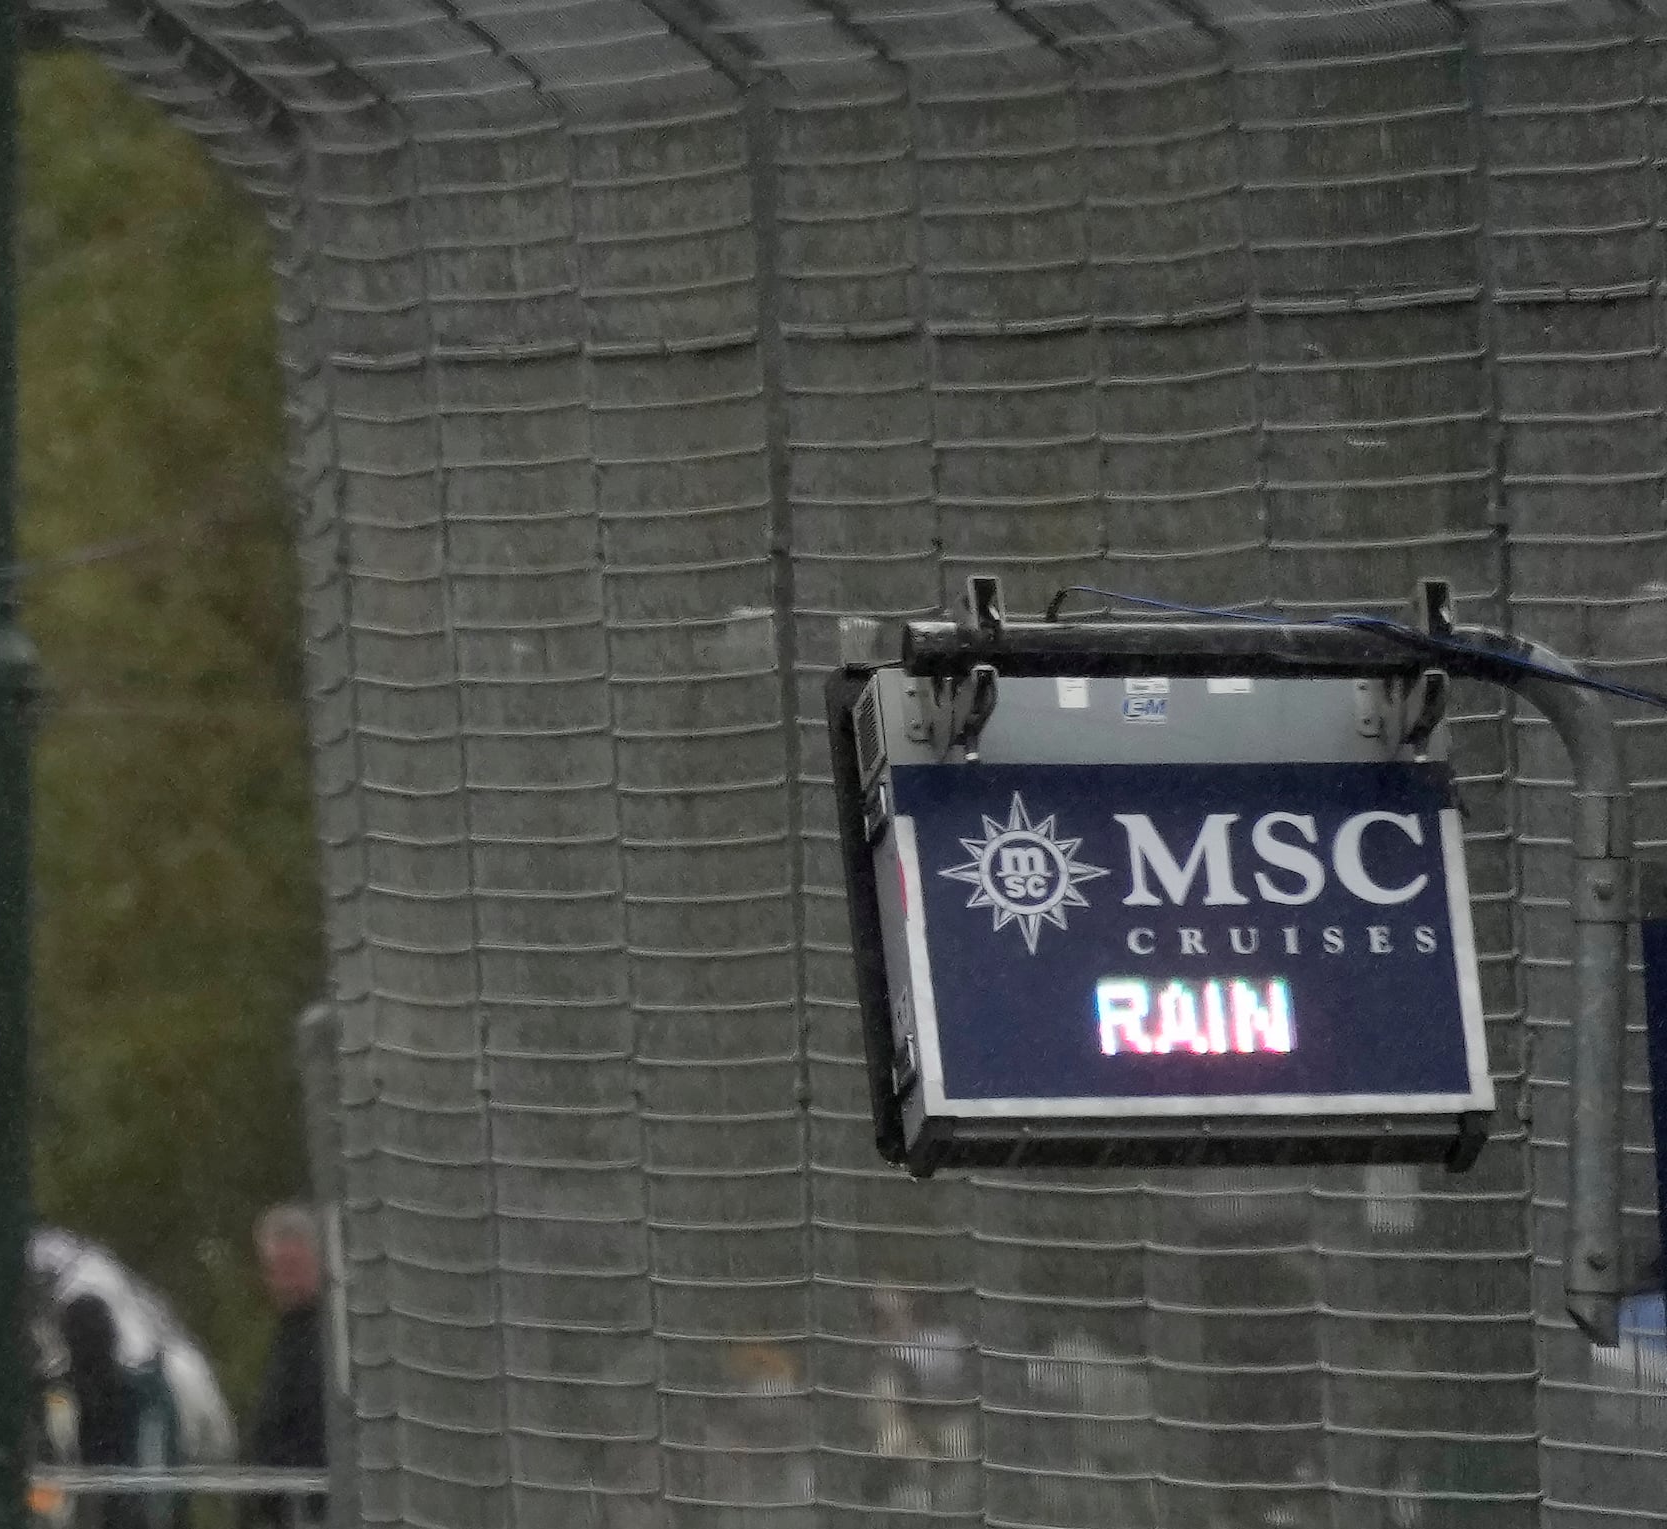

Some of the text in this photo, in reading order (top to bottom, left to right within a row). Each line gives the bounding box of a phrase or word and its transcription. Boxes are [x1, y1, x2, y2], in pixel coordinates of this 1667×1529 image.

[1113, 810, 1429, 905] MSC
[1126, 925, 1438, 955] CRUISES
[1096, 976, 1297, 1055] RAIN
